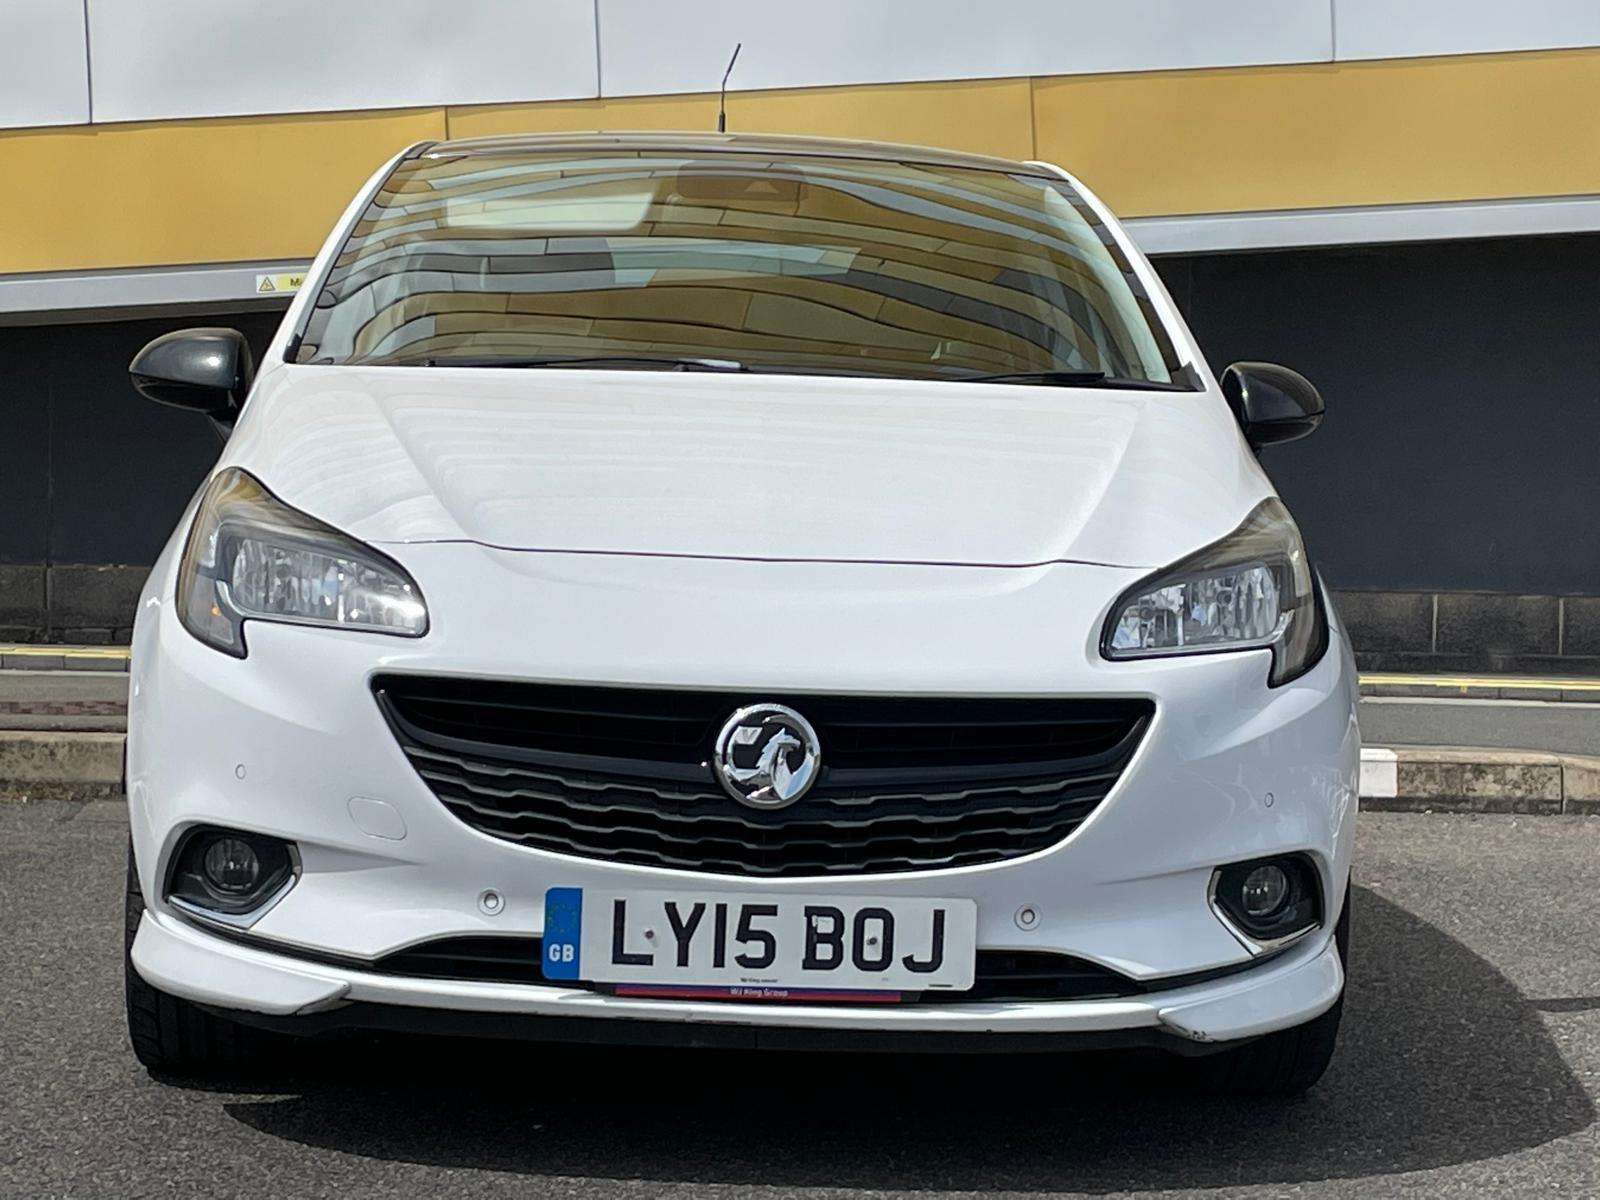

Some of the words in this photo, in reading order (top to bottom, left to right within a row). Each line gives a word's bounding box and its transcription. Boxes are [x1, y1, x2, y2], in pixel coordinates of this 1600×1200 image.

[611, 899, 778, 969] LY15
[802, 905, 946, 973] BOJ
[549, 943, 575, 962] GB
[763, 988, 788, 998] Group
